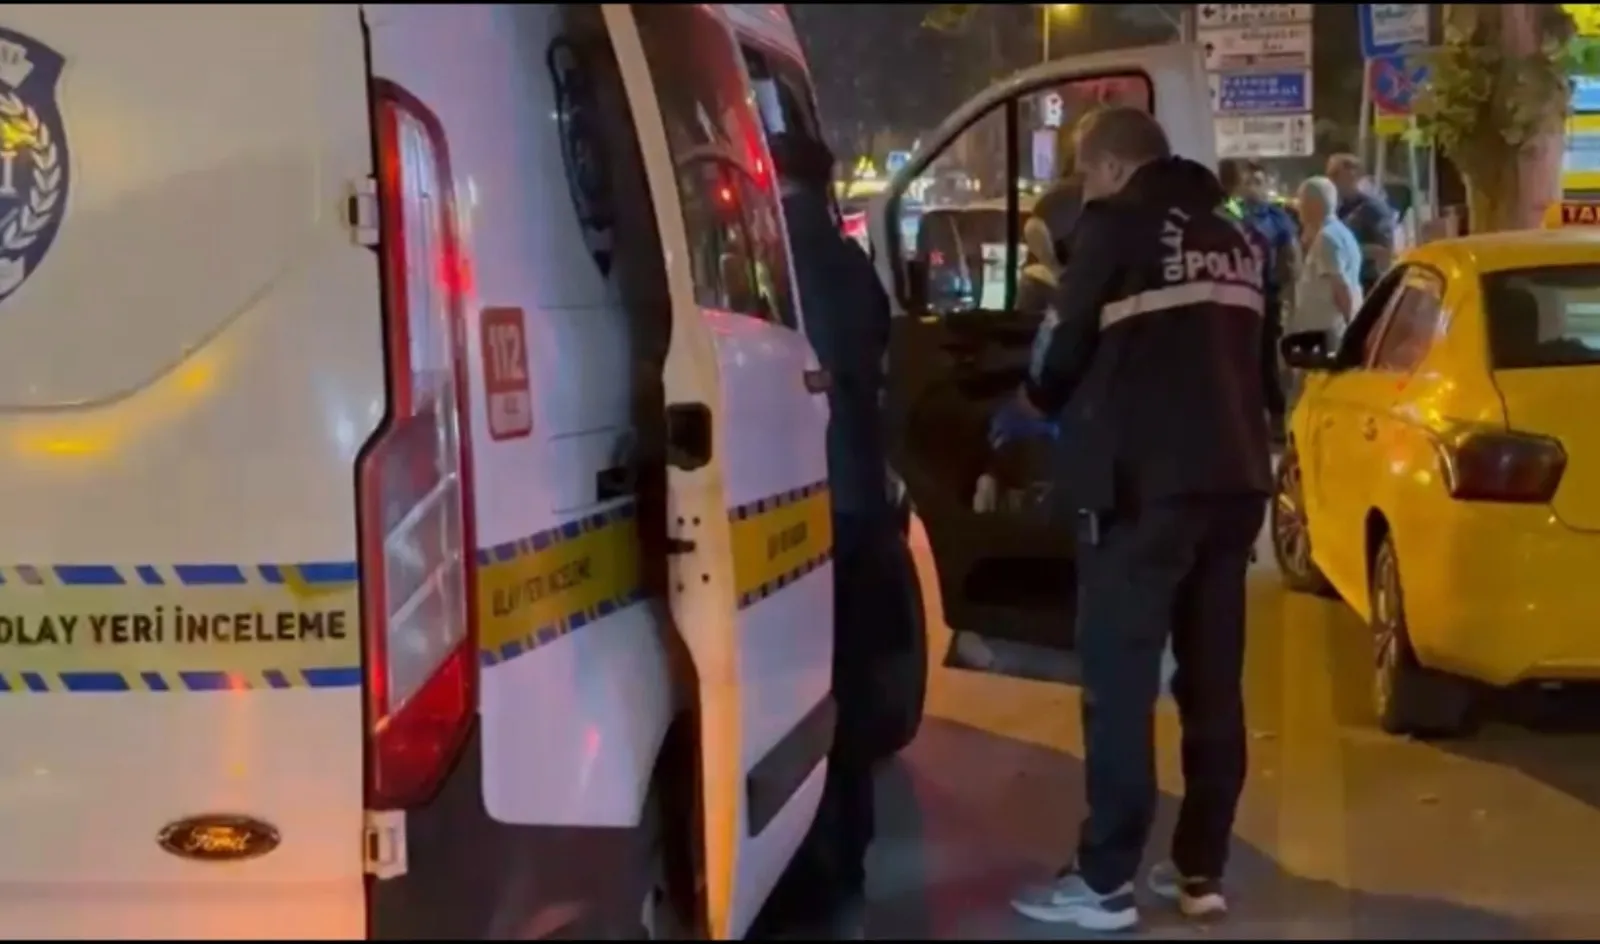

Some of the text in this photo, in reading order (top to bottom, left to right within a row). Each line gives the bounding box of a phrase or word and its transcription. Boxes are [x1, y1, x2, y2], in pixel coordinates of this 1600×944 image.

[1564, 206, 1600, 223] TA
[489, 324, 524, 381] 112
[0, 606, 346, 645] OLAY YERİ İNCELEME
